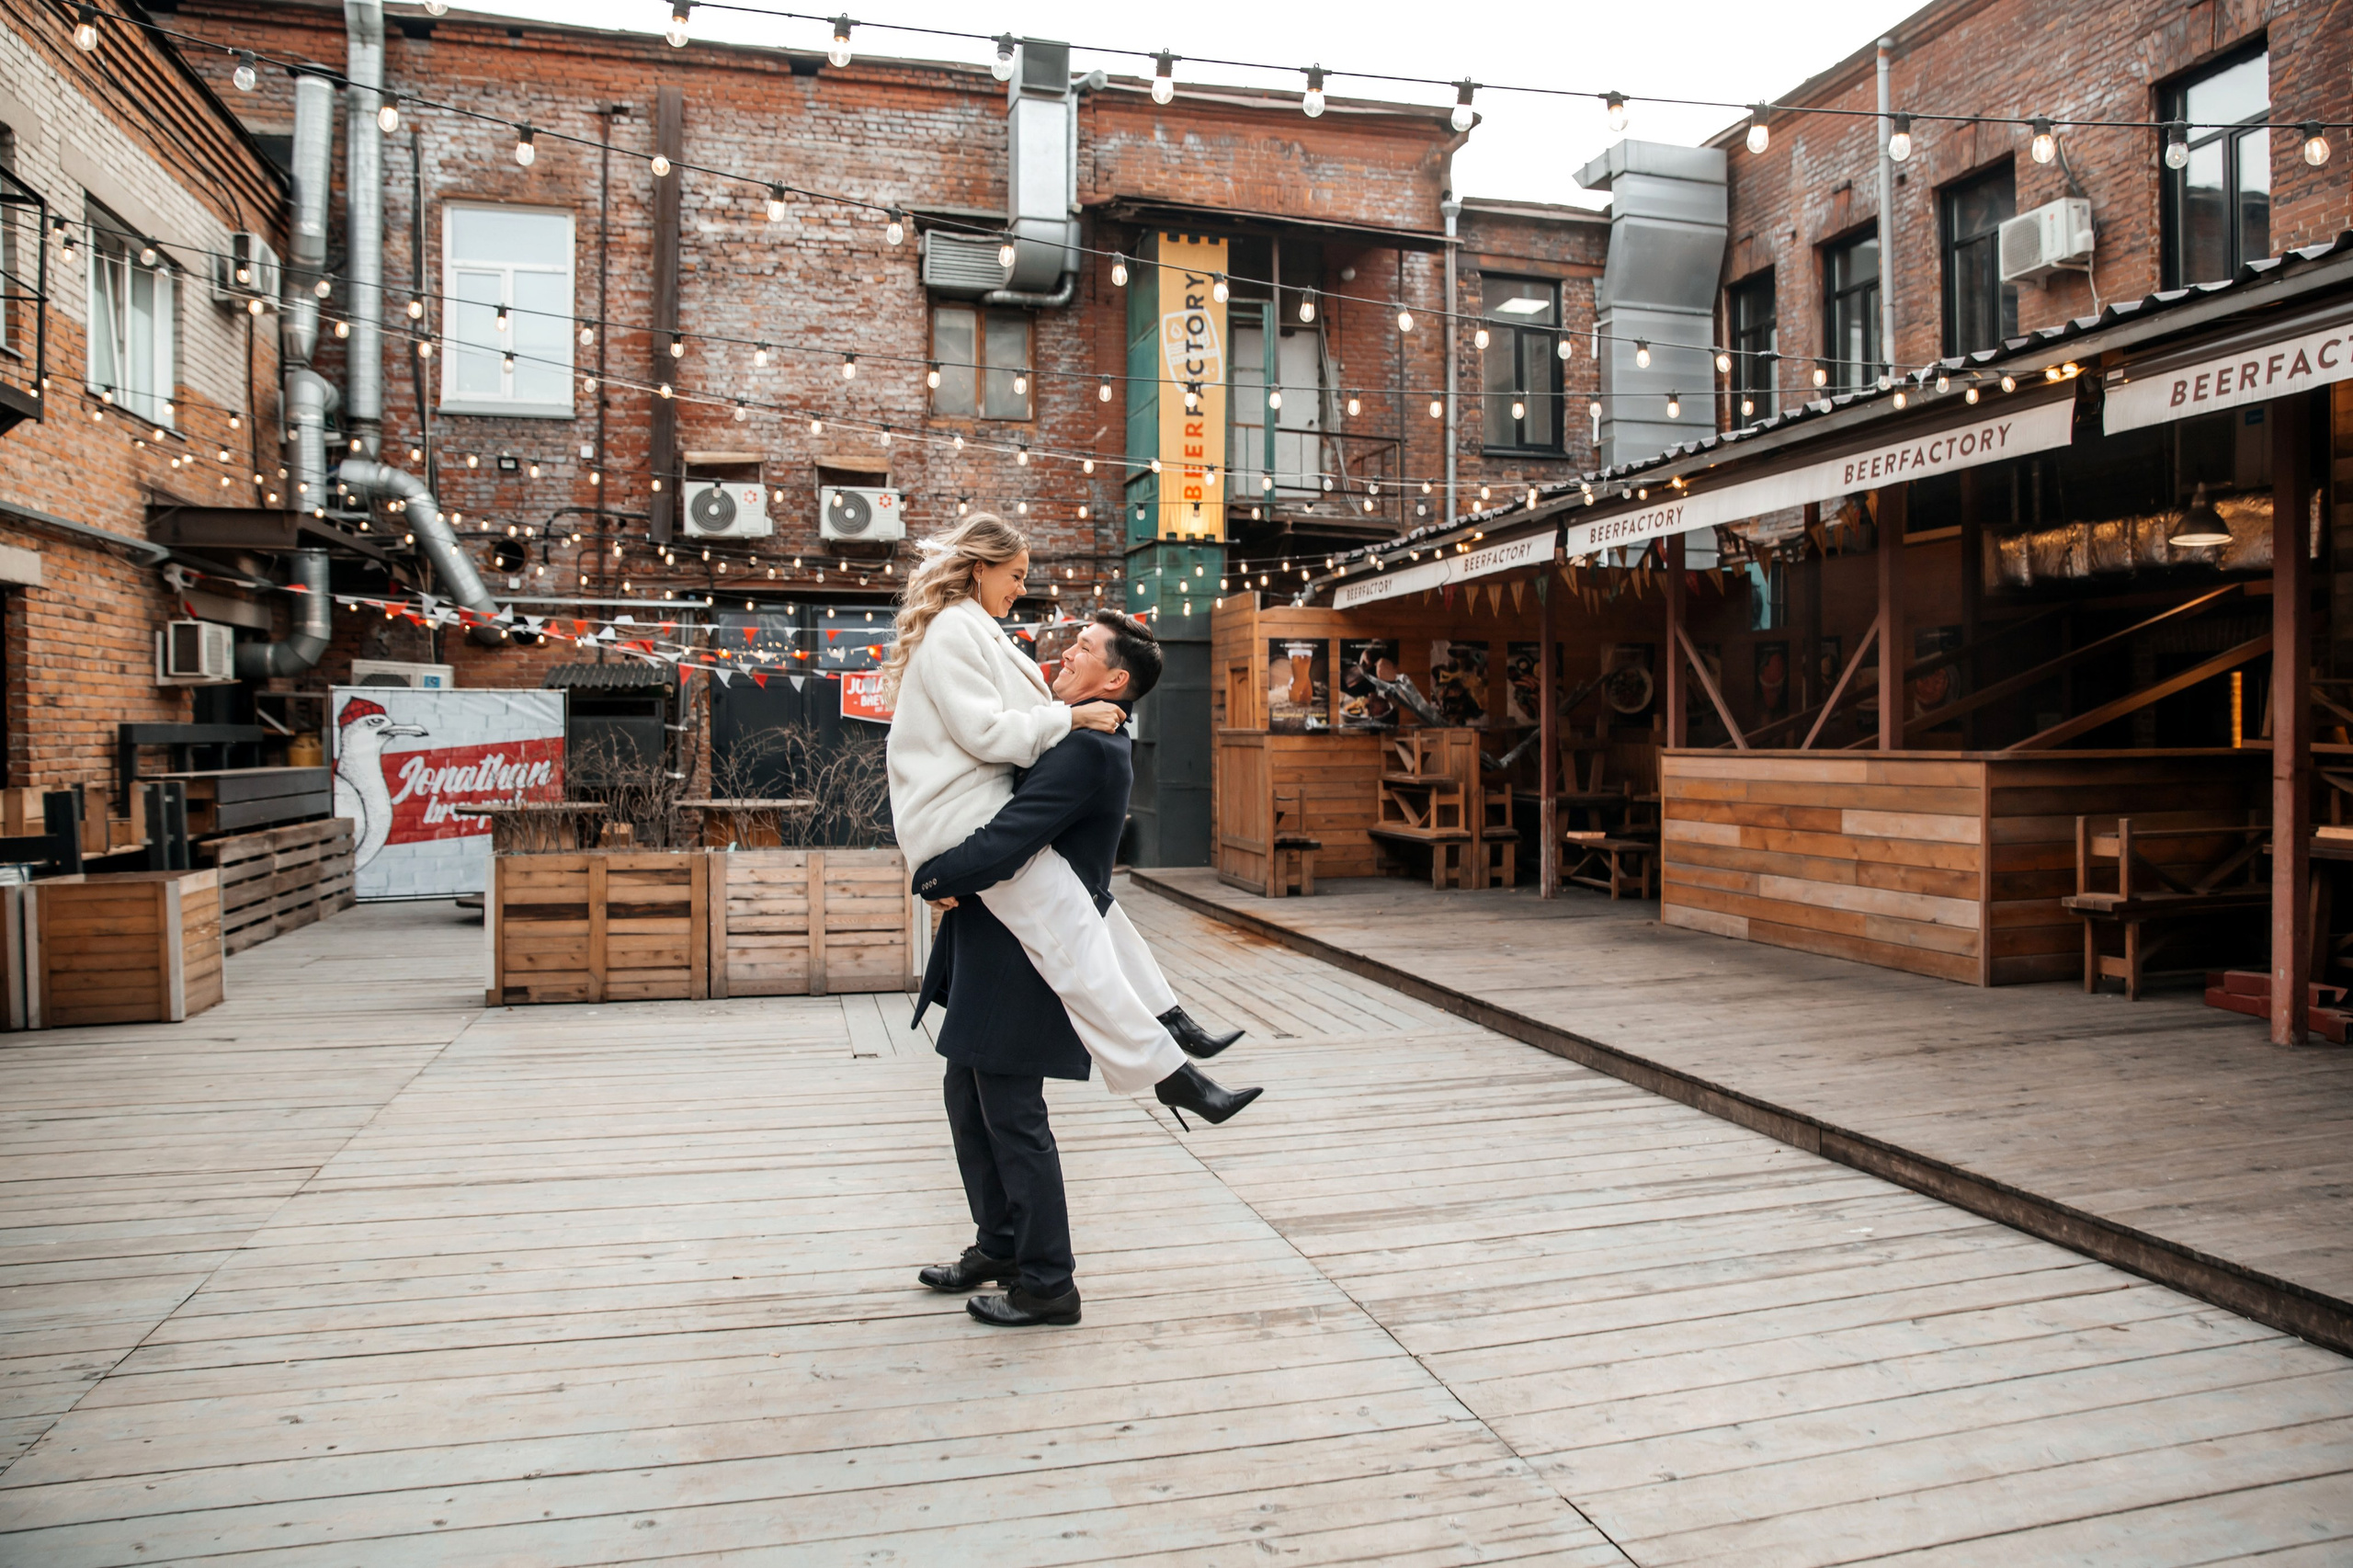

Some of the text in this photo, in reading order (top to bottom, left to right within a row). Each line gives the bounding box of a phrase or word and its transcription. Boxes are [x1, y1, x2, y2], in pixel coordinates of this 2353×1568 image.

[1844, 422, 2012, 485] BEERFACTORY
[1590, 506, 1684, 544] BEERFACTORY
[1463, 542, 1533, 573] BEERFACTORY
[1346, 579, 1393, 601] BEERFACTORY
[392, 753, 553, 805] Jonathan
